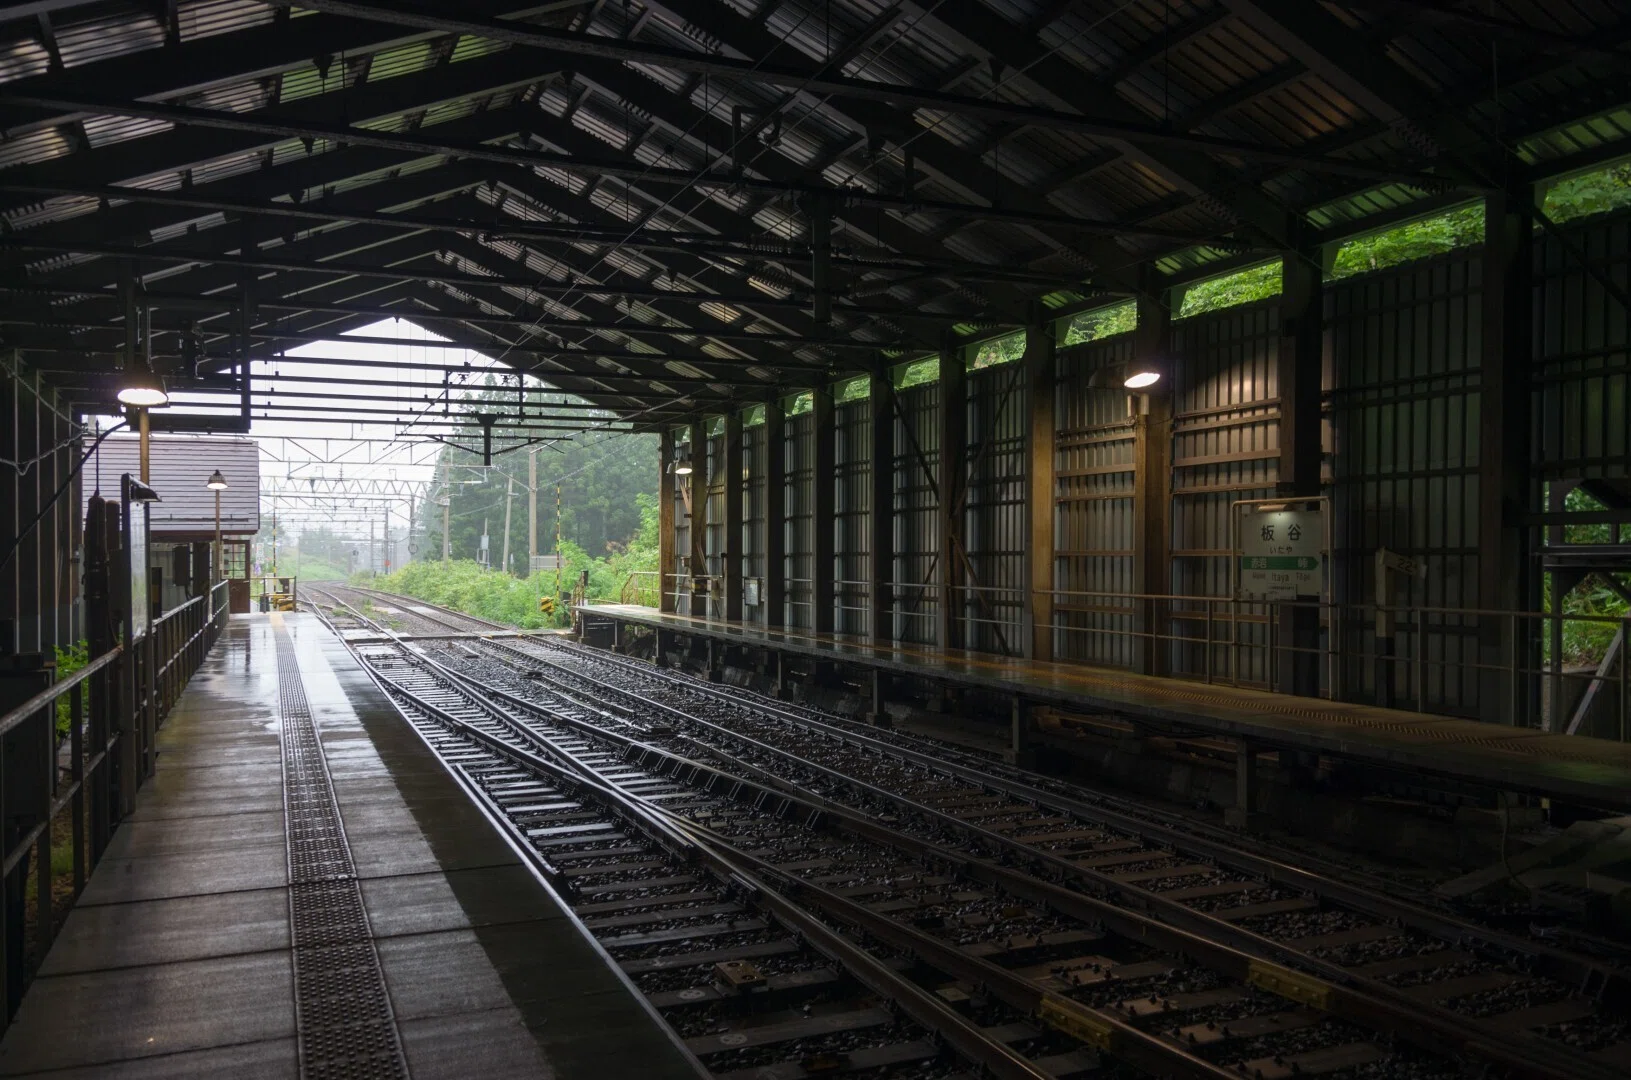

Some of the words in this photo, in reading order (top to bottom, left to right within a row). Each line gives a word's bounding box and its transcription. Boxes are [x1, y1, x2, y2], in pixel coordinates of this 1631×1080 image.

[1261, 523, 1302, 541] 板谷
[1269, 546, 1293, 554] いたや
[1271, 572, 1290, 583] Itaya
